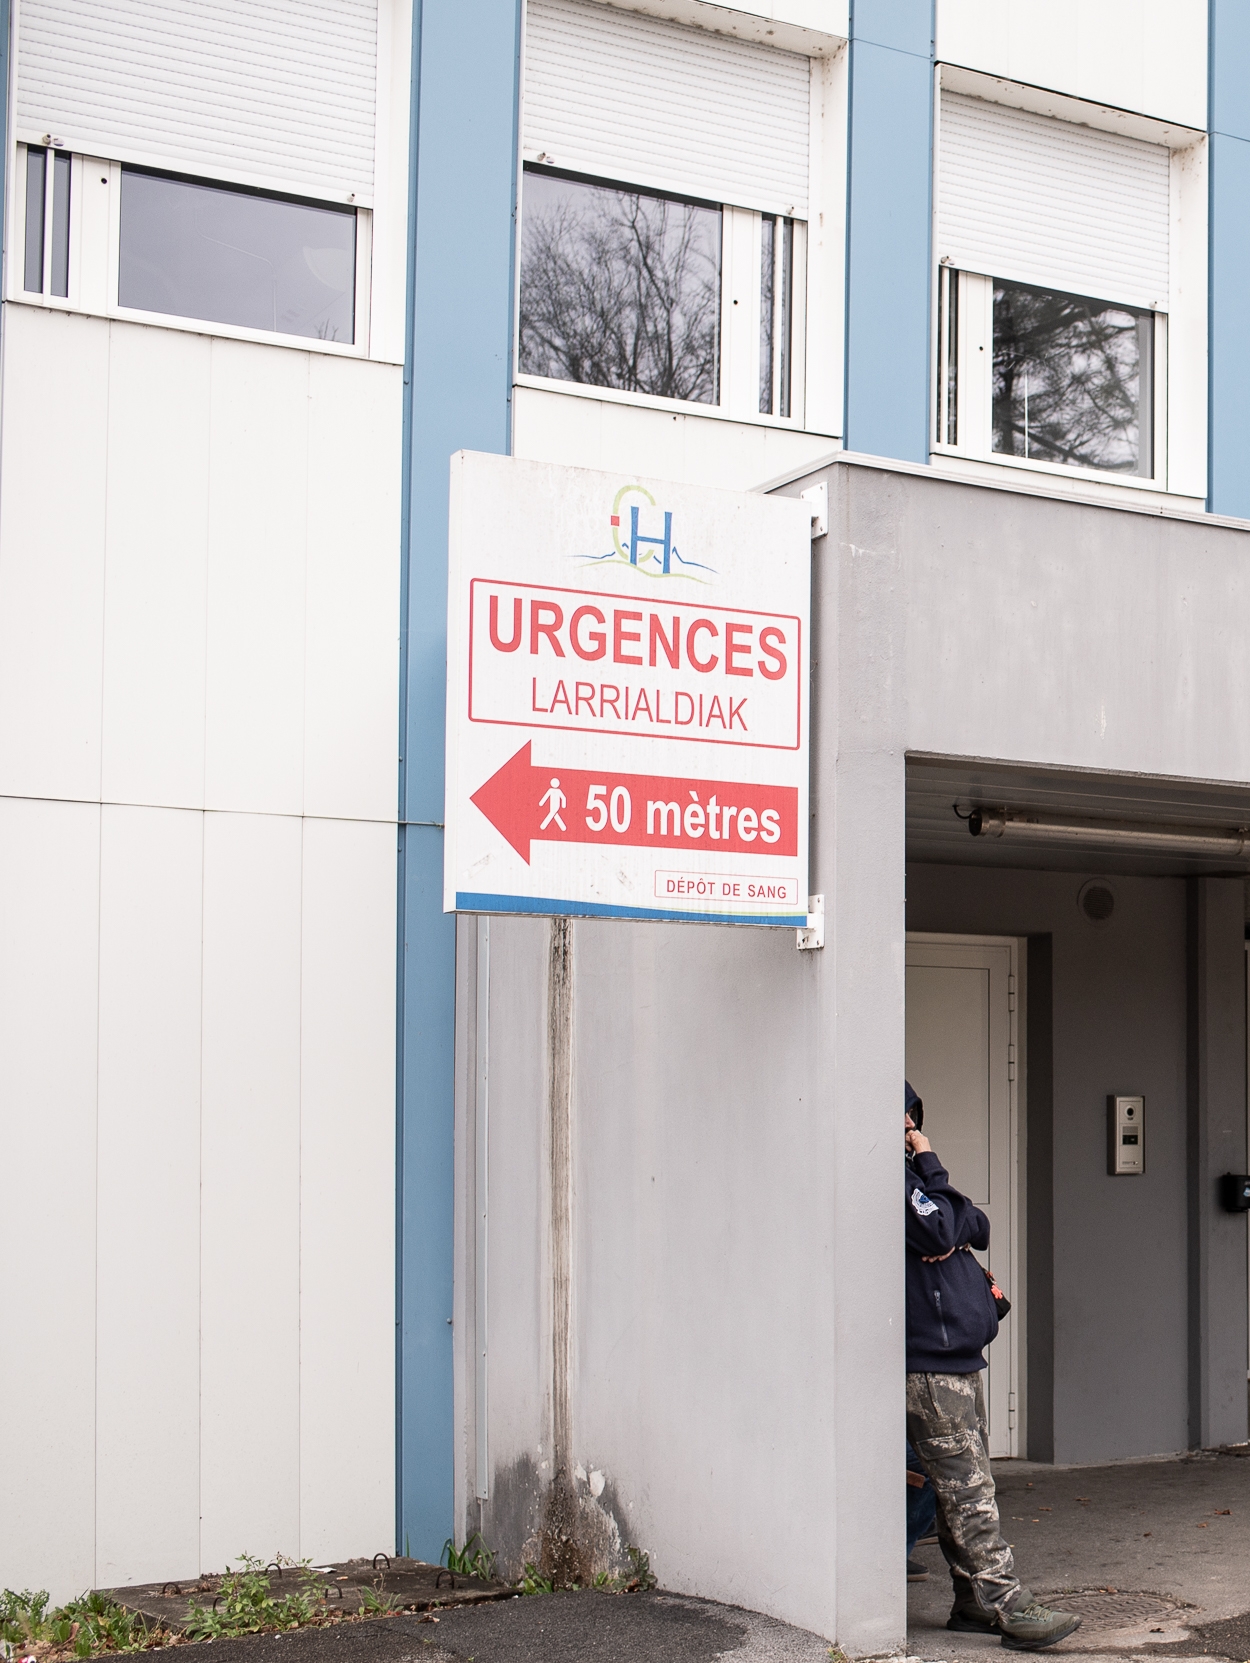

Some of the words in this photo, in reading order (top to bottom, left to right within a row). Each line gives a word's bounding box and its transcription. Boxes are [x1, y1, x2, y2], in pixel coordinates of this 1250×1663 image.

[489, 595, 787, 680] URGENCES
[531, 677, 749, 731] LARRIALDIAK
[584, 783, 632, 834] 50
[646, 790, 782, 844] mètres
[666, 877, 716, 895] DÉPÔT
[722, 883, 741, 897] DE
[747, 884, 787, 899] SANG
